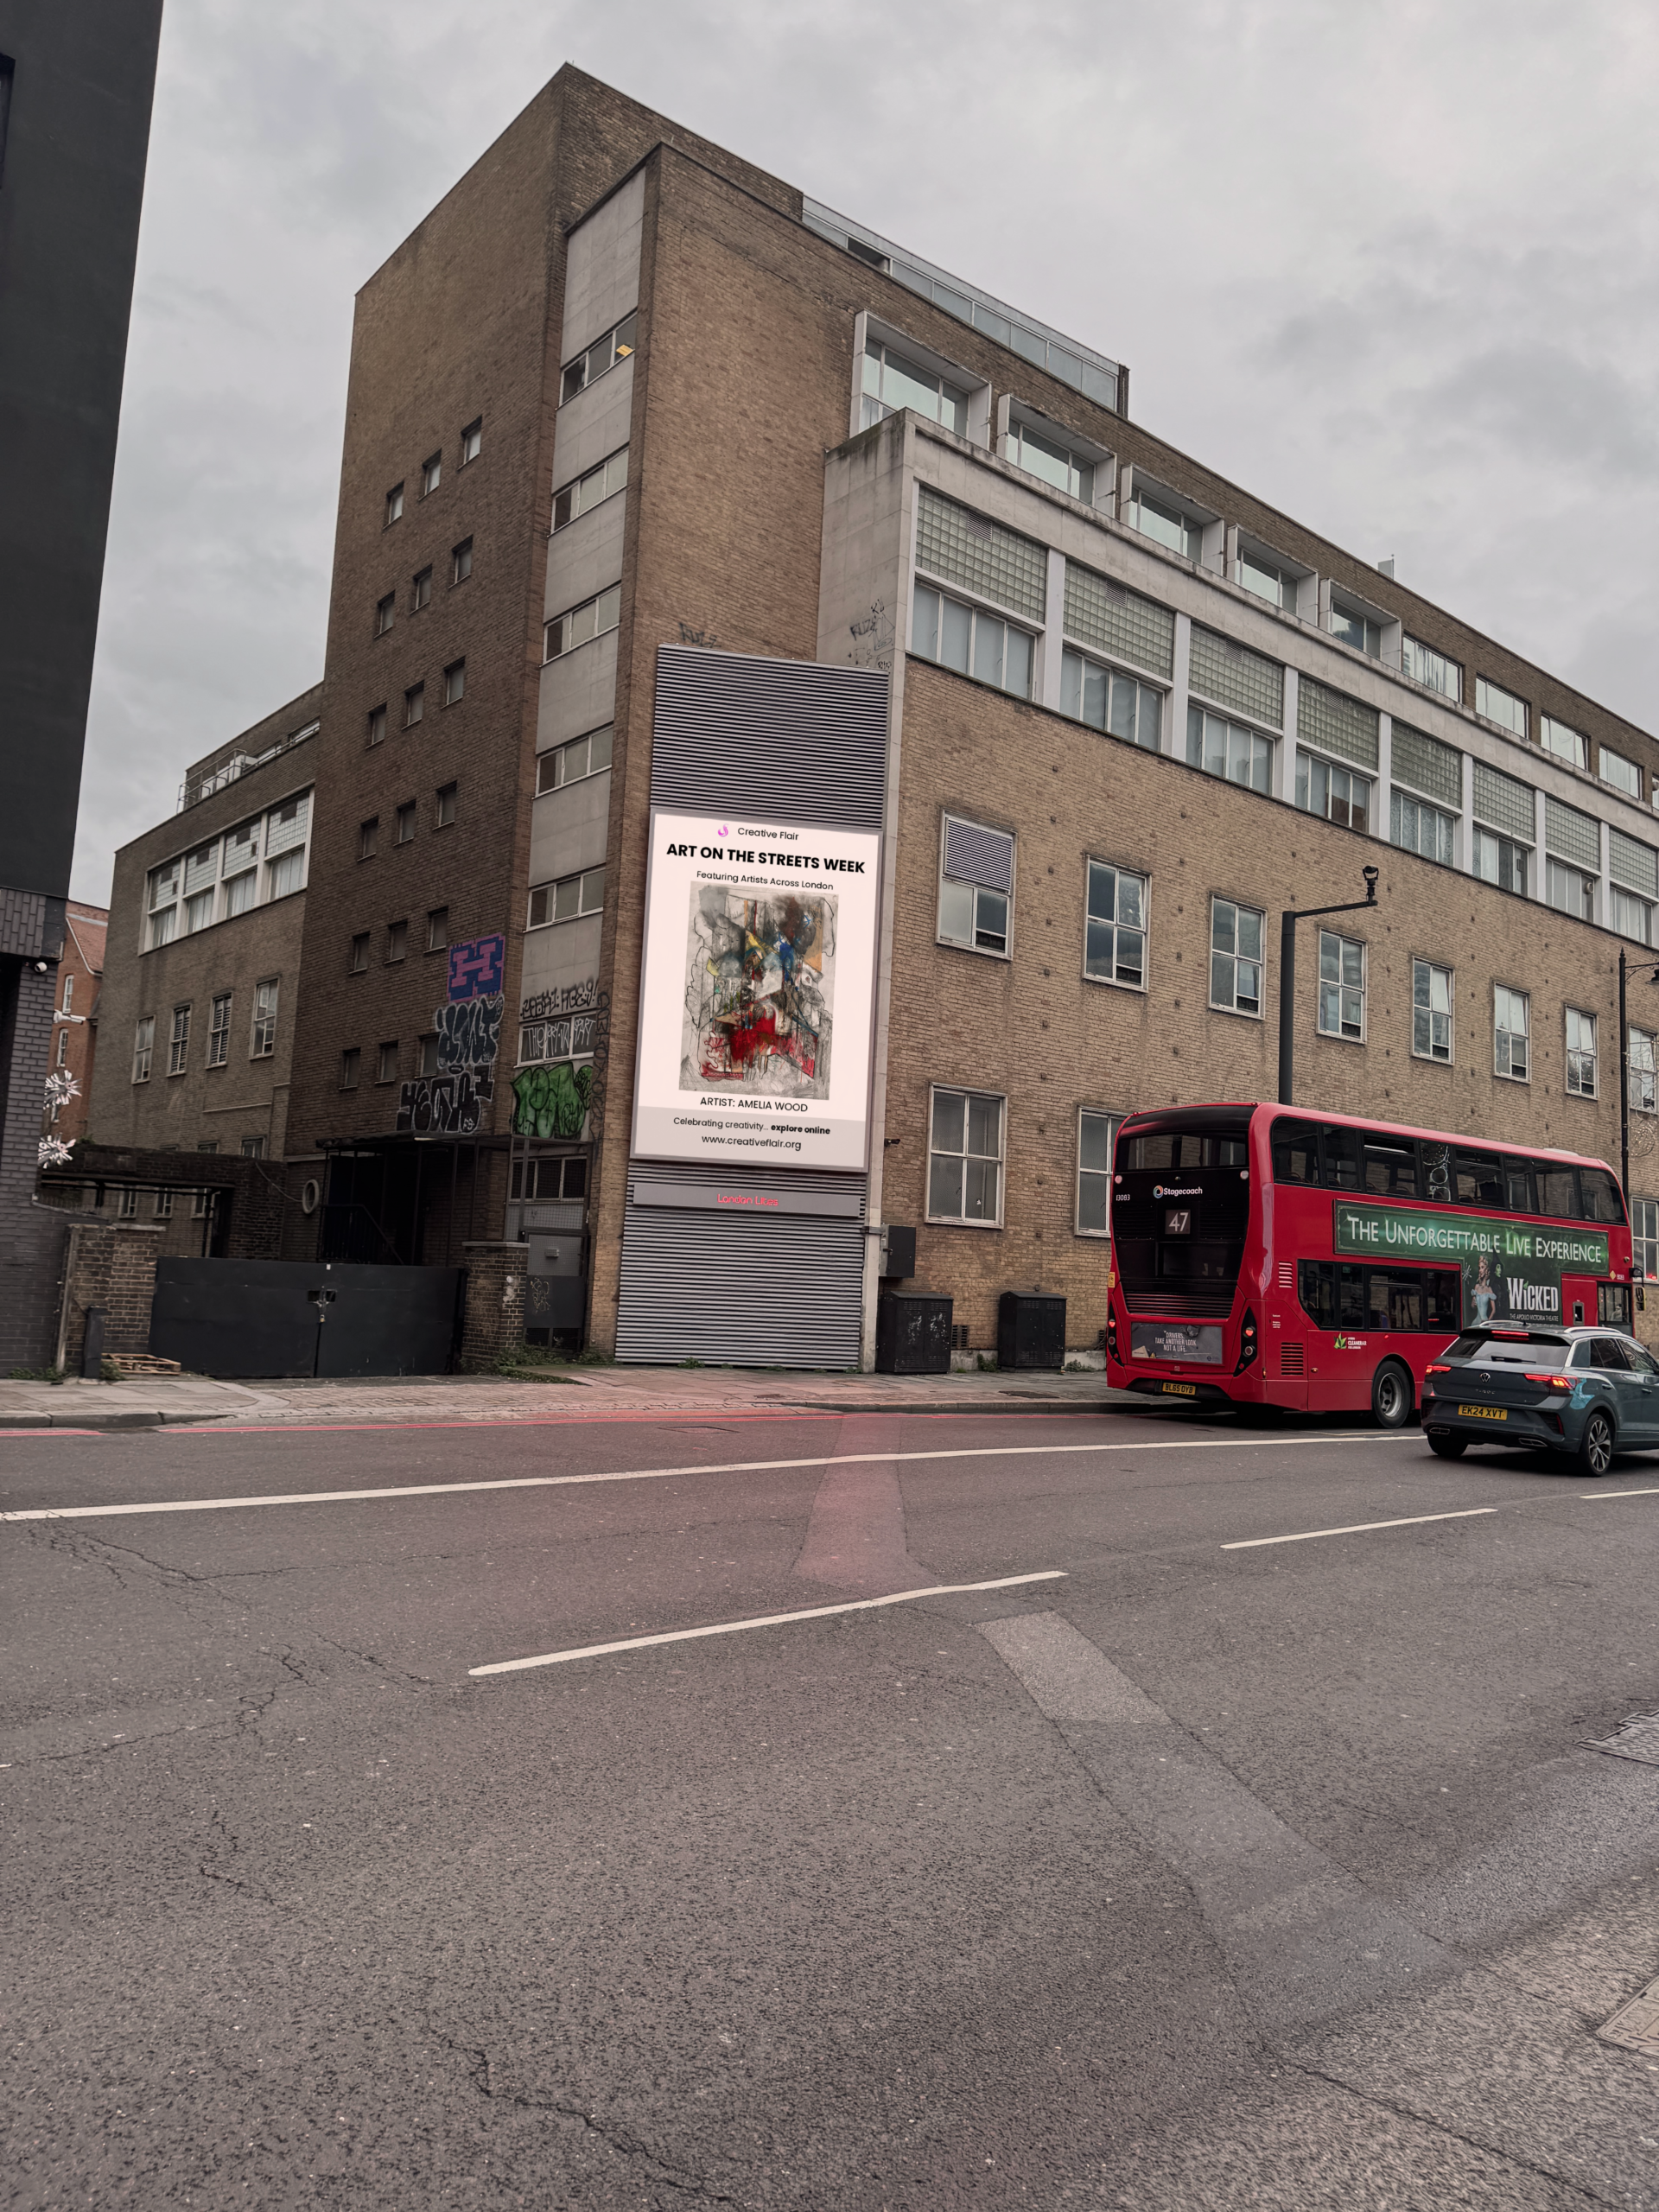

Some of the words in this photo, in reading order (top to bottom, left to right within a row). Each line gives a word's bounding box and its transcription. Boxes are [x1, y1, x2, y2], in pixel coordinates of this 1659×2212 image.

[737, 827, 778, 839] Creative
[779, 831, 799, 841] Flair
[666, 843, 697, 857] ART
[700, 847, 723, 860] ON
[727, 849, 755, 863] THE
[758, 852, 820, 869] STREETS
[823, 858, 866, 874] WEEK
[696, 871, 739, 883] Featuring
[741, 874, 768, 885] Artists
[770, 877, 799, 887] Across
[801, 880, 834, 891] London
[700, 1096, 735, 1108] ARTIST:
[737, 1099, 772, 1110] AMELIA
[774, 1102, 808, 1112] WOOD
[673, 1116, 723, 1129] Celebrating
[725, 1121, 769, 1132] creativity...
[771, 1124, 803, 1135] explore
[804, 1126, 830, 1135] online
[702, 1135, 802, 1152] www.creativeflair.org
[717, 1193, 753, 1205] London
[1163, 1186, 1203, 1197] Stagecoach
[1168, 1212, 1189, 1232] 47
[1348, 1217, 1380, 1242] THE
[1385, 1221, 1500, 1254] UNFORGETTABLE
[1506, 1236, 1531, 1256] LIVE
[1536, 1237, 1601, 1263] EXPERIENCE
[1461, 1406, 1484, 1417] EK24
[1485, 1408, 1504, 1419] XVT
